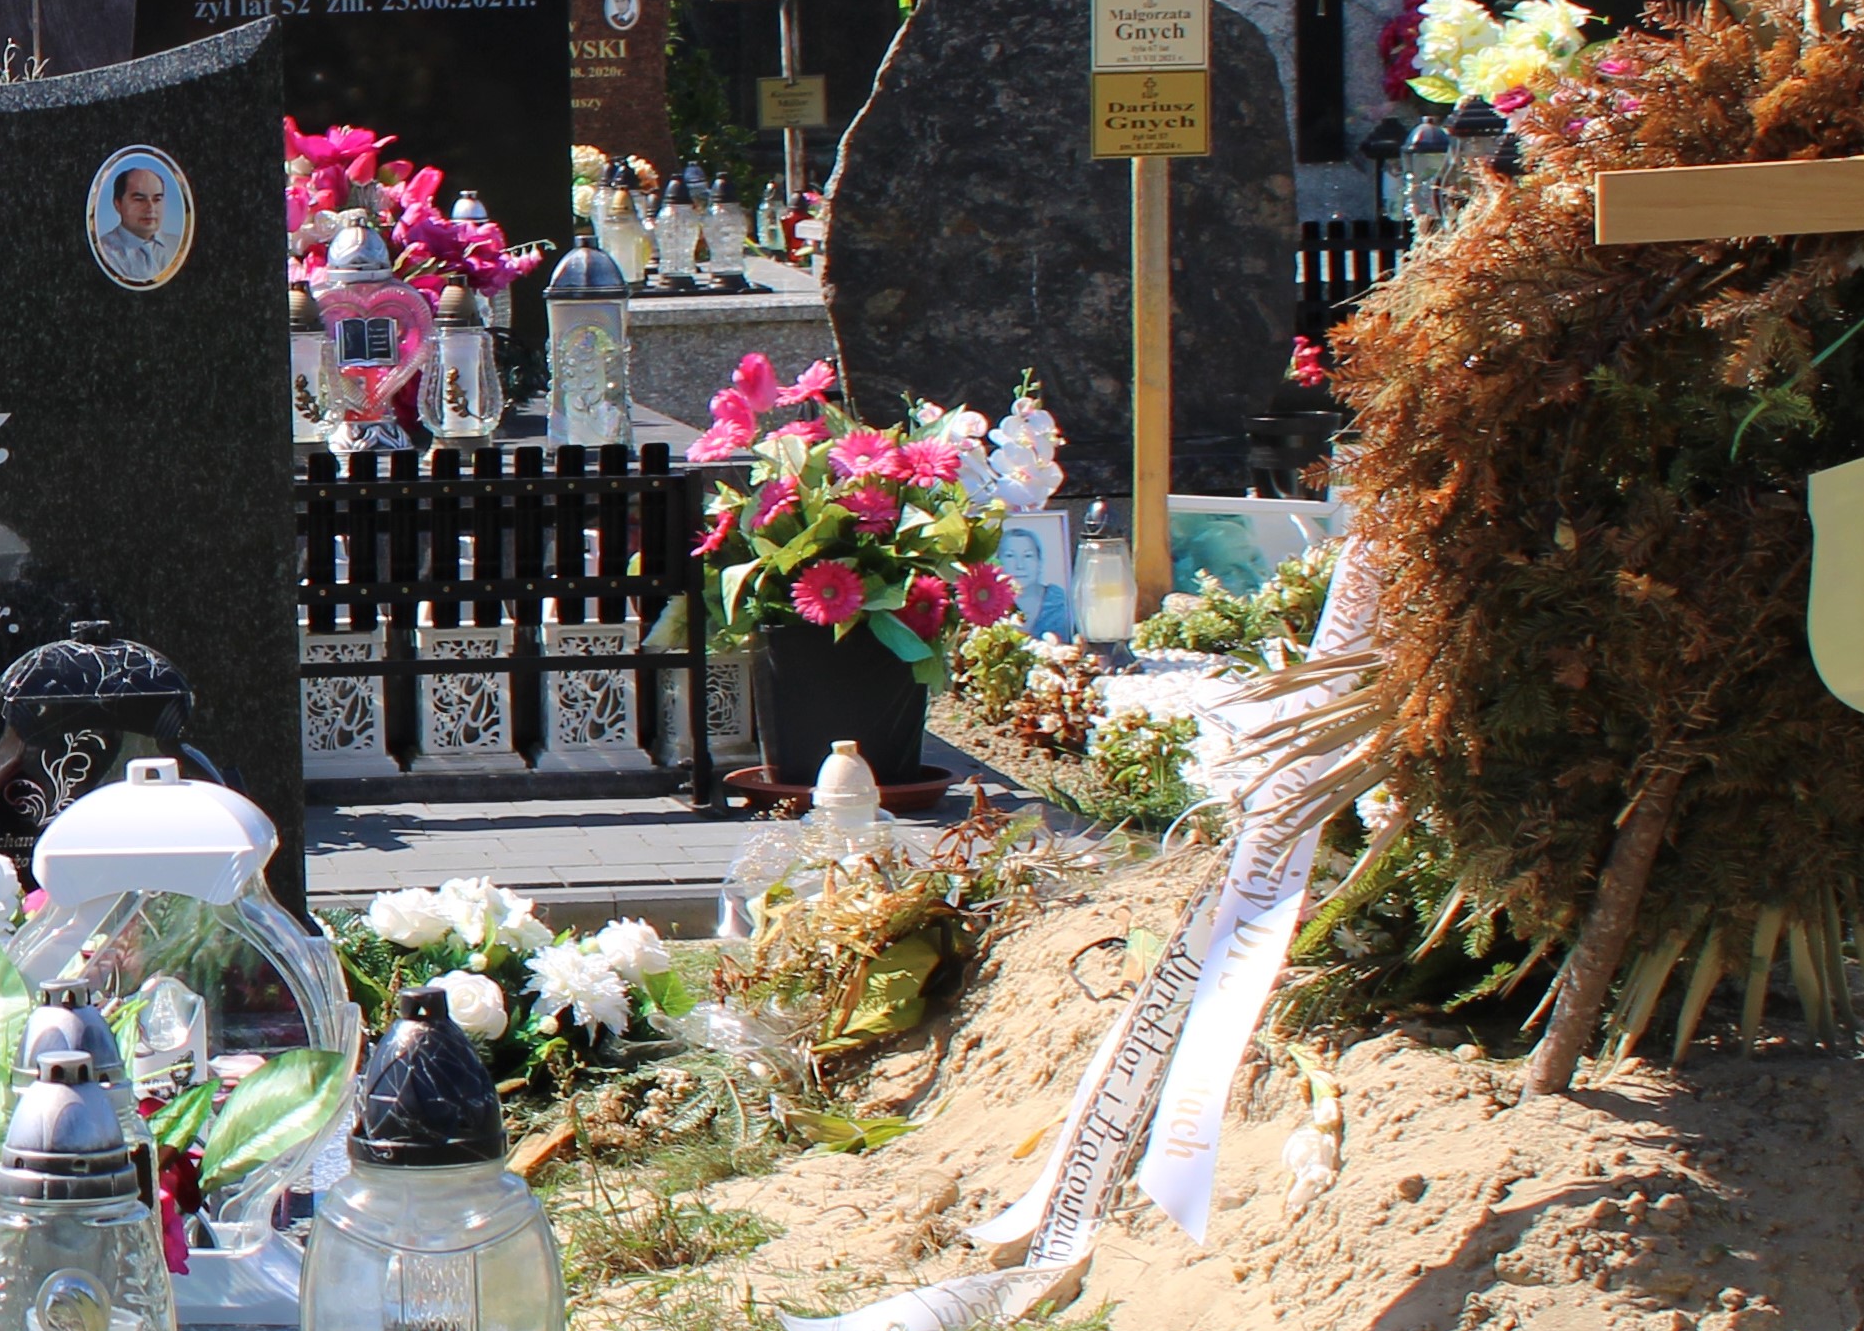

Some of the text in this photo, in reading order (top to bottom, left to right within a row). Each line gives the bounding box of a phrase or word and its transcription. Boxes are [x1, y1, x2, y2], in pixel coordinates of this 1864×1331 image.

[1115, 22, 1185, 44] Gnych
[571, 98, 603, 111] uszy
[1108, 101, 1195, 114] Dariusz
[1105, 115, 1195, 132] Gnych
